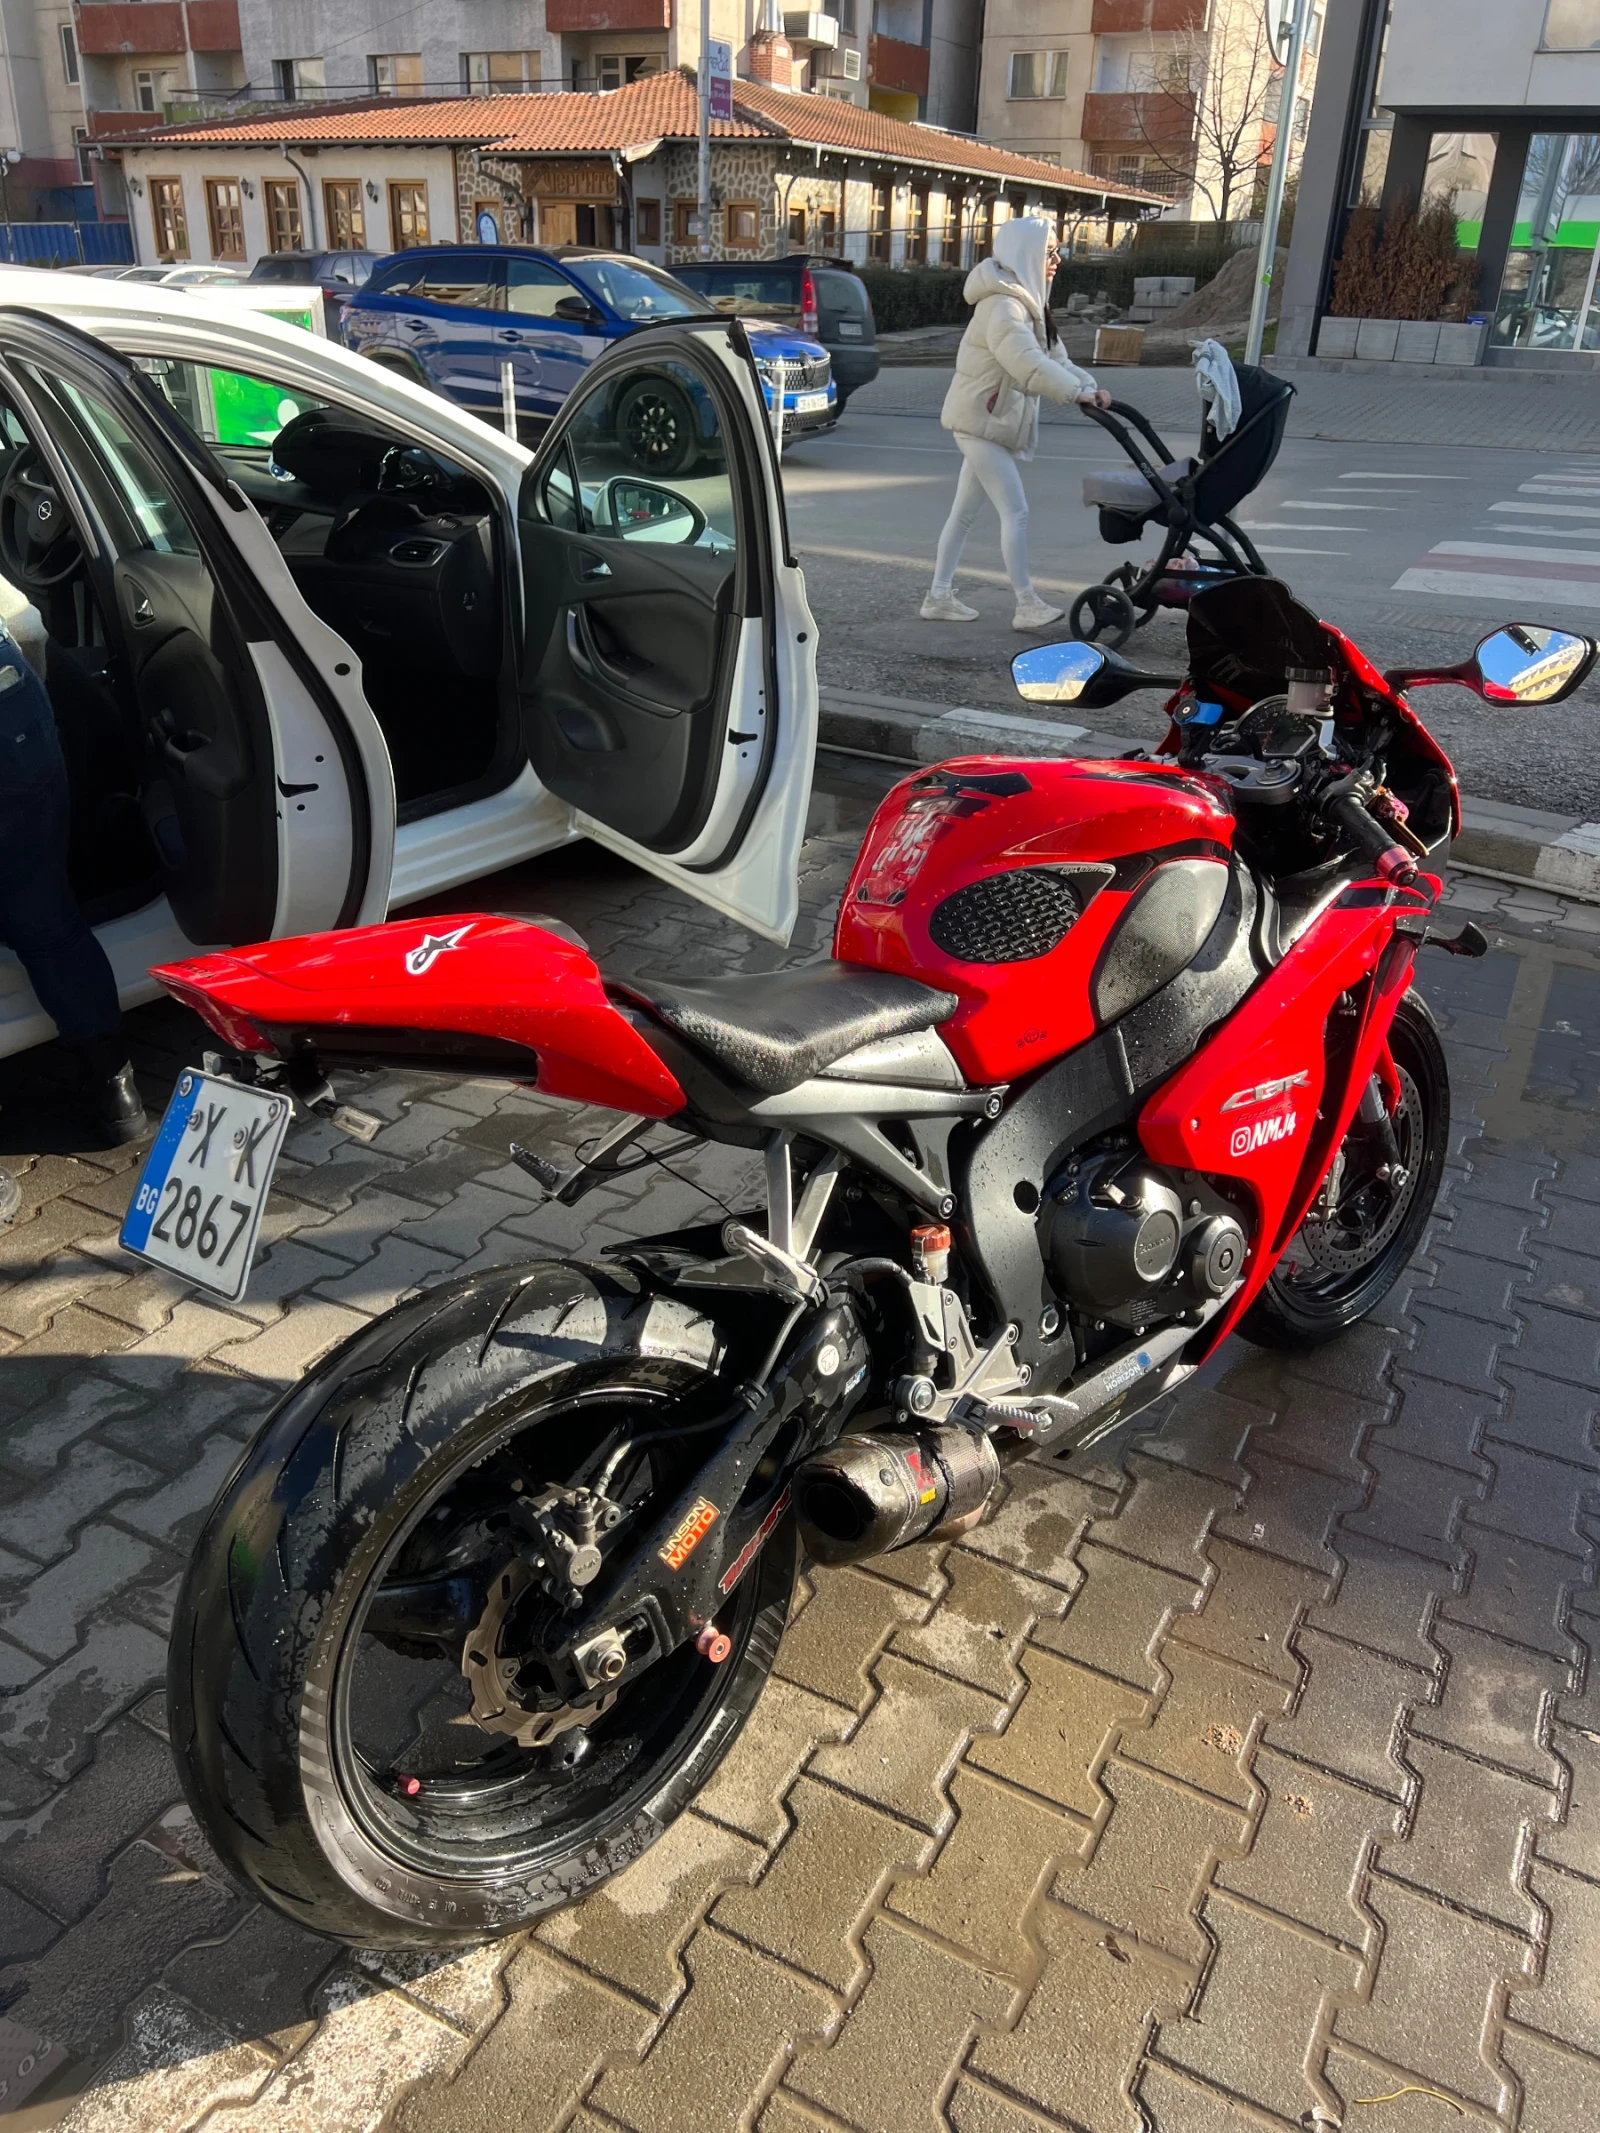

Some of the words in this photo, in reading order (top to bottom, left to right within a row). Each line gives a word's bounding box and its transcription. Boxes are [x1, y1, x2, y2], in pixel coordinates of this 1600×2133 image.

[1249, 1112, 1296, 1152] NMJ4
[136, 1183, 159, 1215] BG
[151, 1177, 252, 1267] 2867
[1102, 1364, 1122, 1385] CHASE
[1105, 1364, 1141, 1392] HORIZON
[660, 1499, 707, 1560] LINSON
[667, 1507, 715, 1570] MOTO
